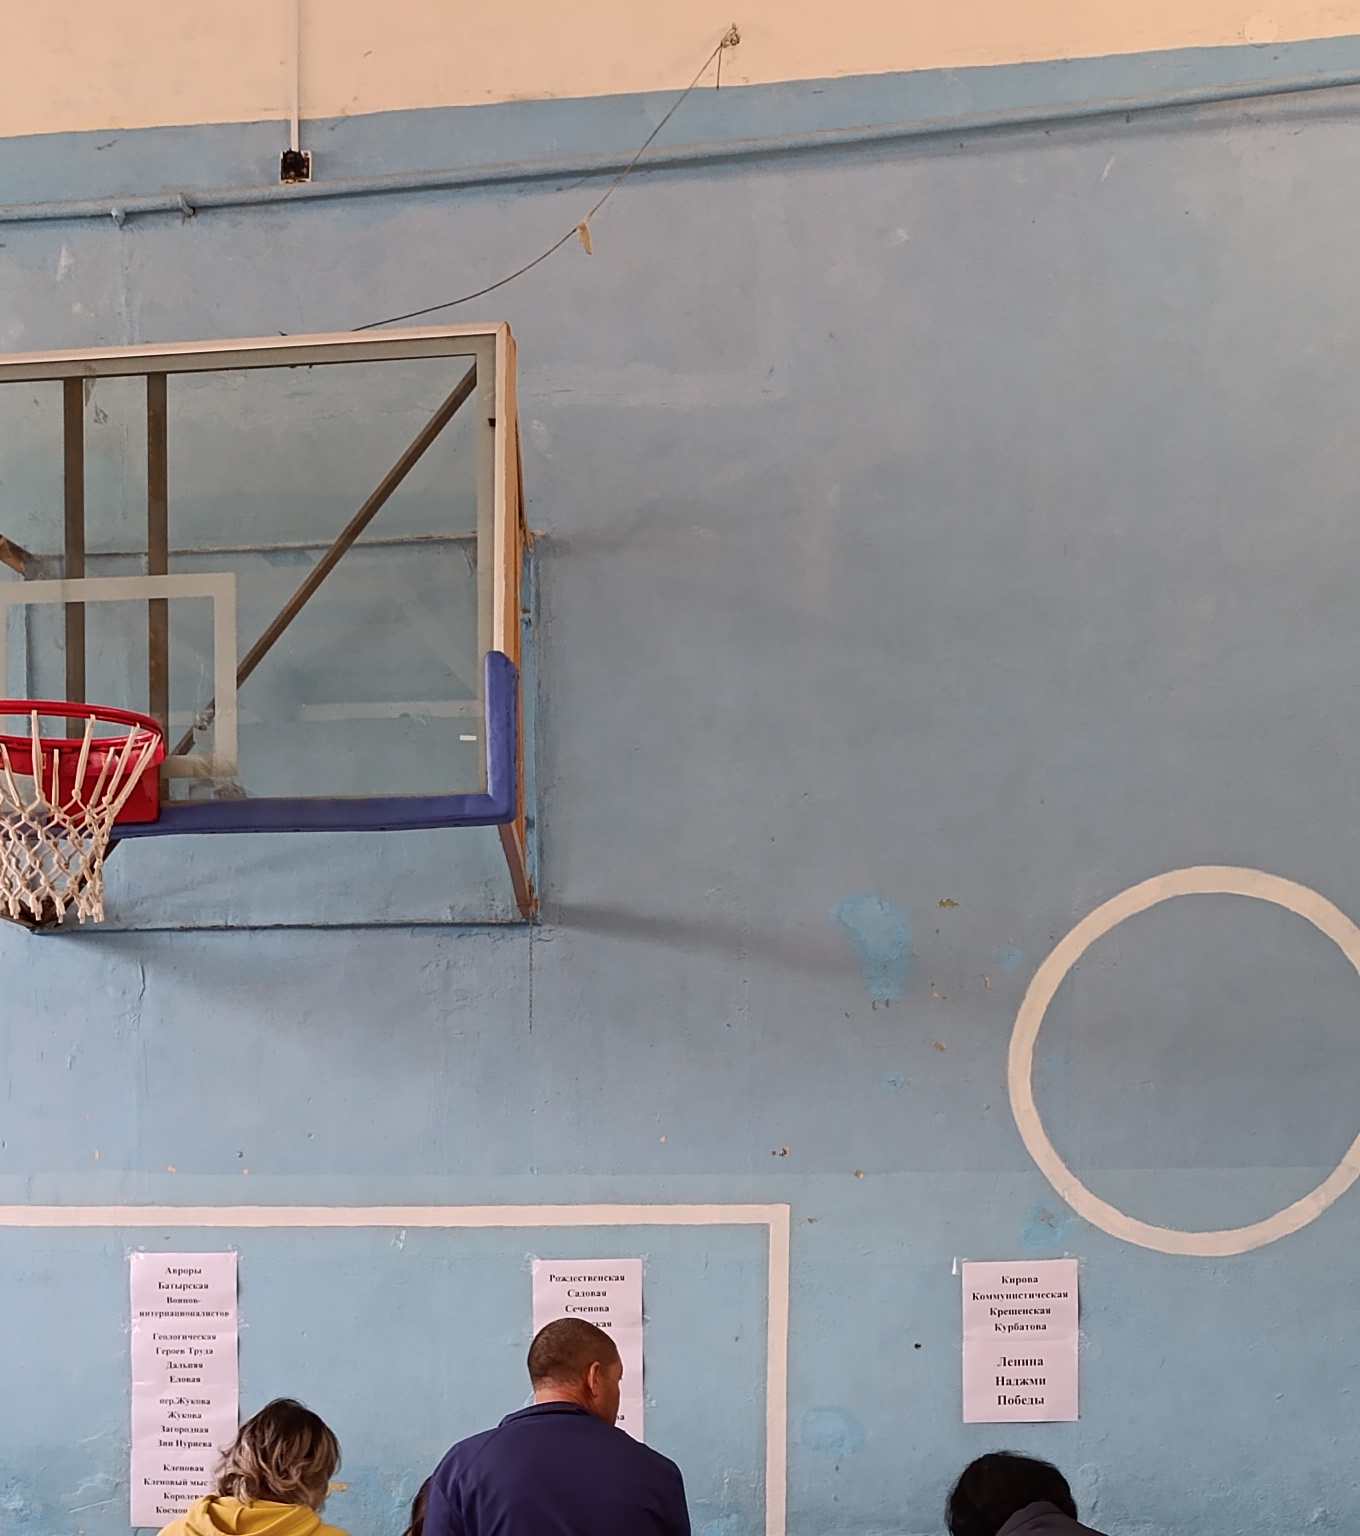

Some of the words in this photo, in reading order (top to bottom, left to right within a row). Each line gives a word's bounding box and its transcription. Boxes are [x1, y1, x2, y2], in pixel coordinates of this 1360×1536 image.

[165, 1267, 202, 1276] Авроры
[549, 1274, 625, 1283] Рождественская
[1001, 1276, 1039, 1285] Кирова
[158, 1282, 209, 1291] Батырская
[567, 1289, 607, 1298] Садовая
[972, 1292, 1068, 1302] Коммунистическая
[565, 1304, 610, 1313] Сеченова
[994, 1323, 1047, 1333] Курбатова
[156, 1347, 185, 1355] Героев
[189, 1347, 214, 1356] Труда
[997, 1357, 1044, 1367] Ленина
[995, 1376, 1046, 1387] Наджми
[997, 1395, 1045, 1406] Победы
[167, 1411, 202, 1420] Жукова
[161, 1425, 209, 1434] Загородная
[163, 1464, 204, 1472] Кленовая
[144, 1478, 187, 1486] Кленовый
